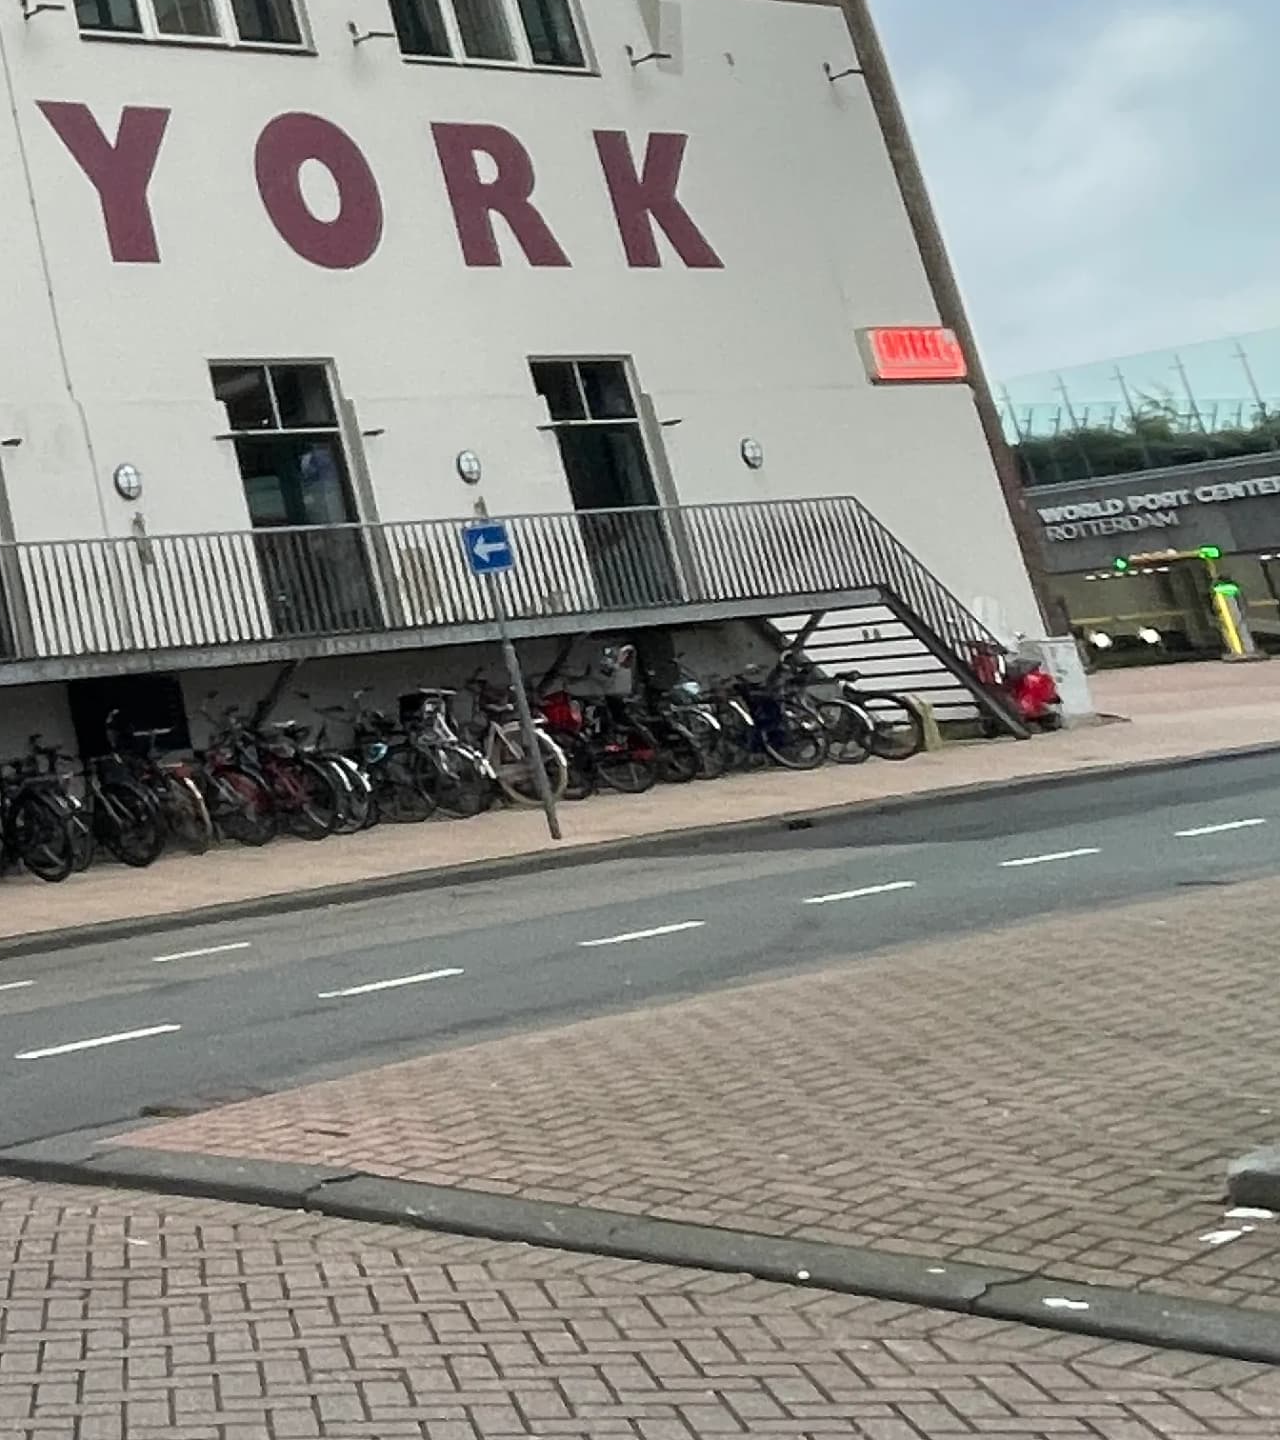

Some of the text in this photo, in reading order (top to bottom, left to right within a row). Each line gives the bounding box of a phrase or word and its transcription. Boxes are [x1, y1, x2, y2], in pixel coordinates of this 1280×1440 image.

[34, 99, 726, 270] YORK
[1037, 498, 1125, 524] WORLD
[1126, 489, 1191, 512] PORT
[1045, 510, 1181, 542] ROTTERDAM
